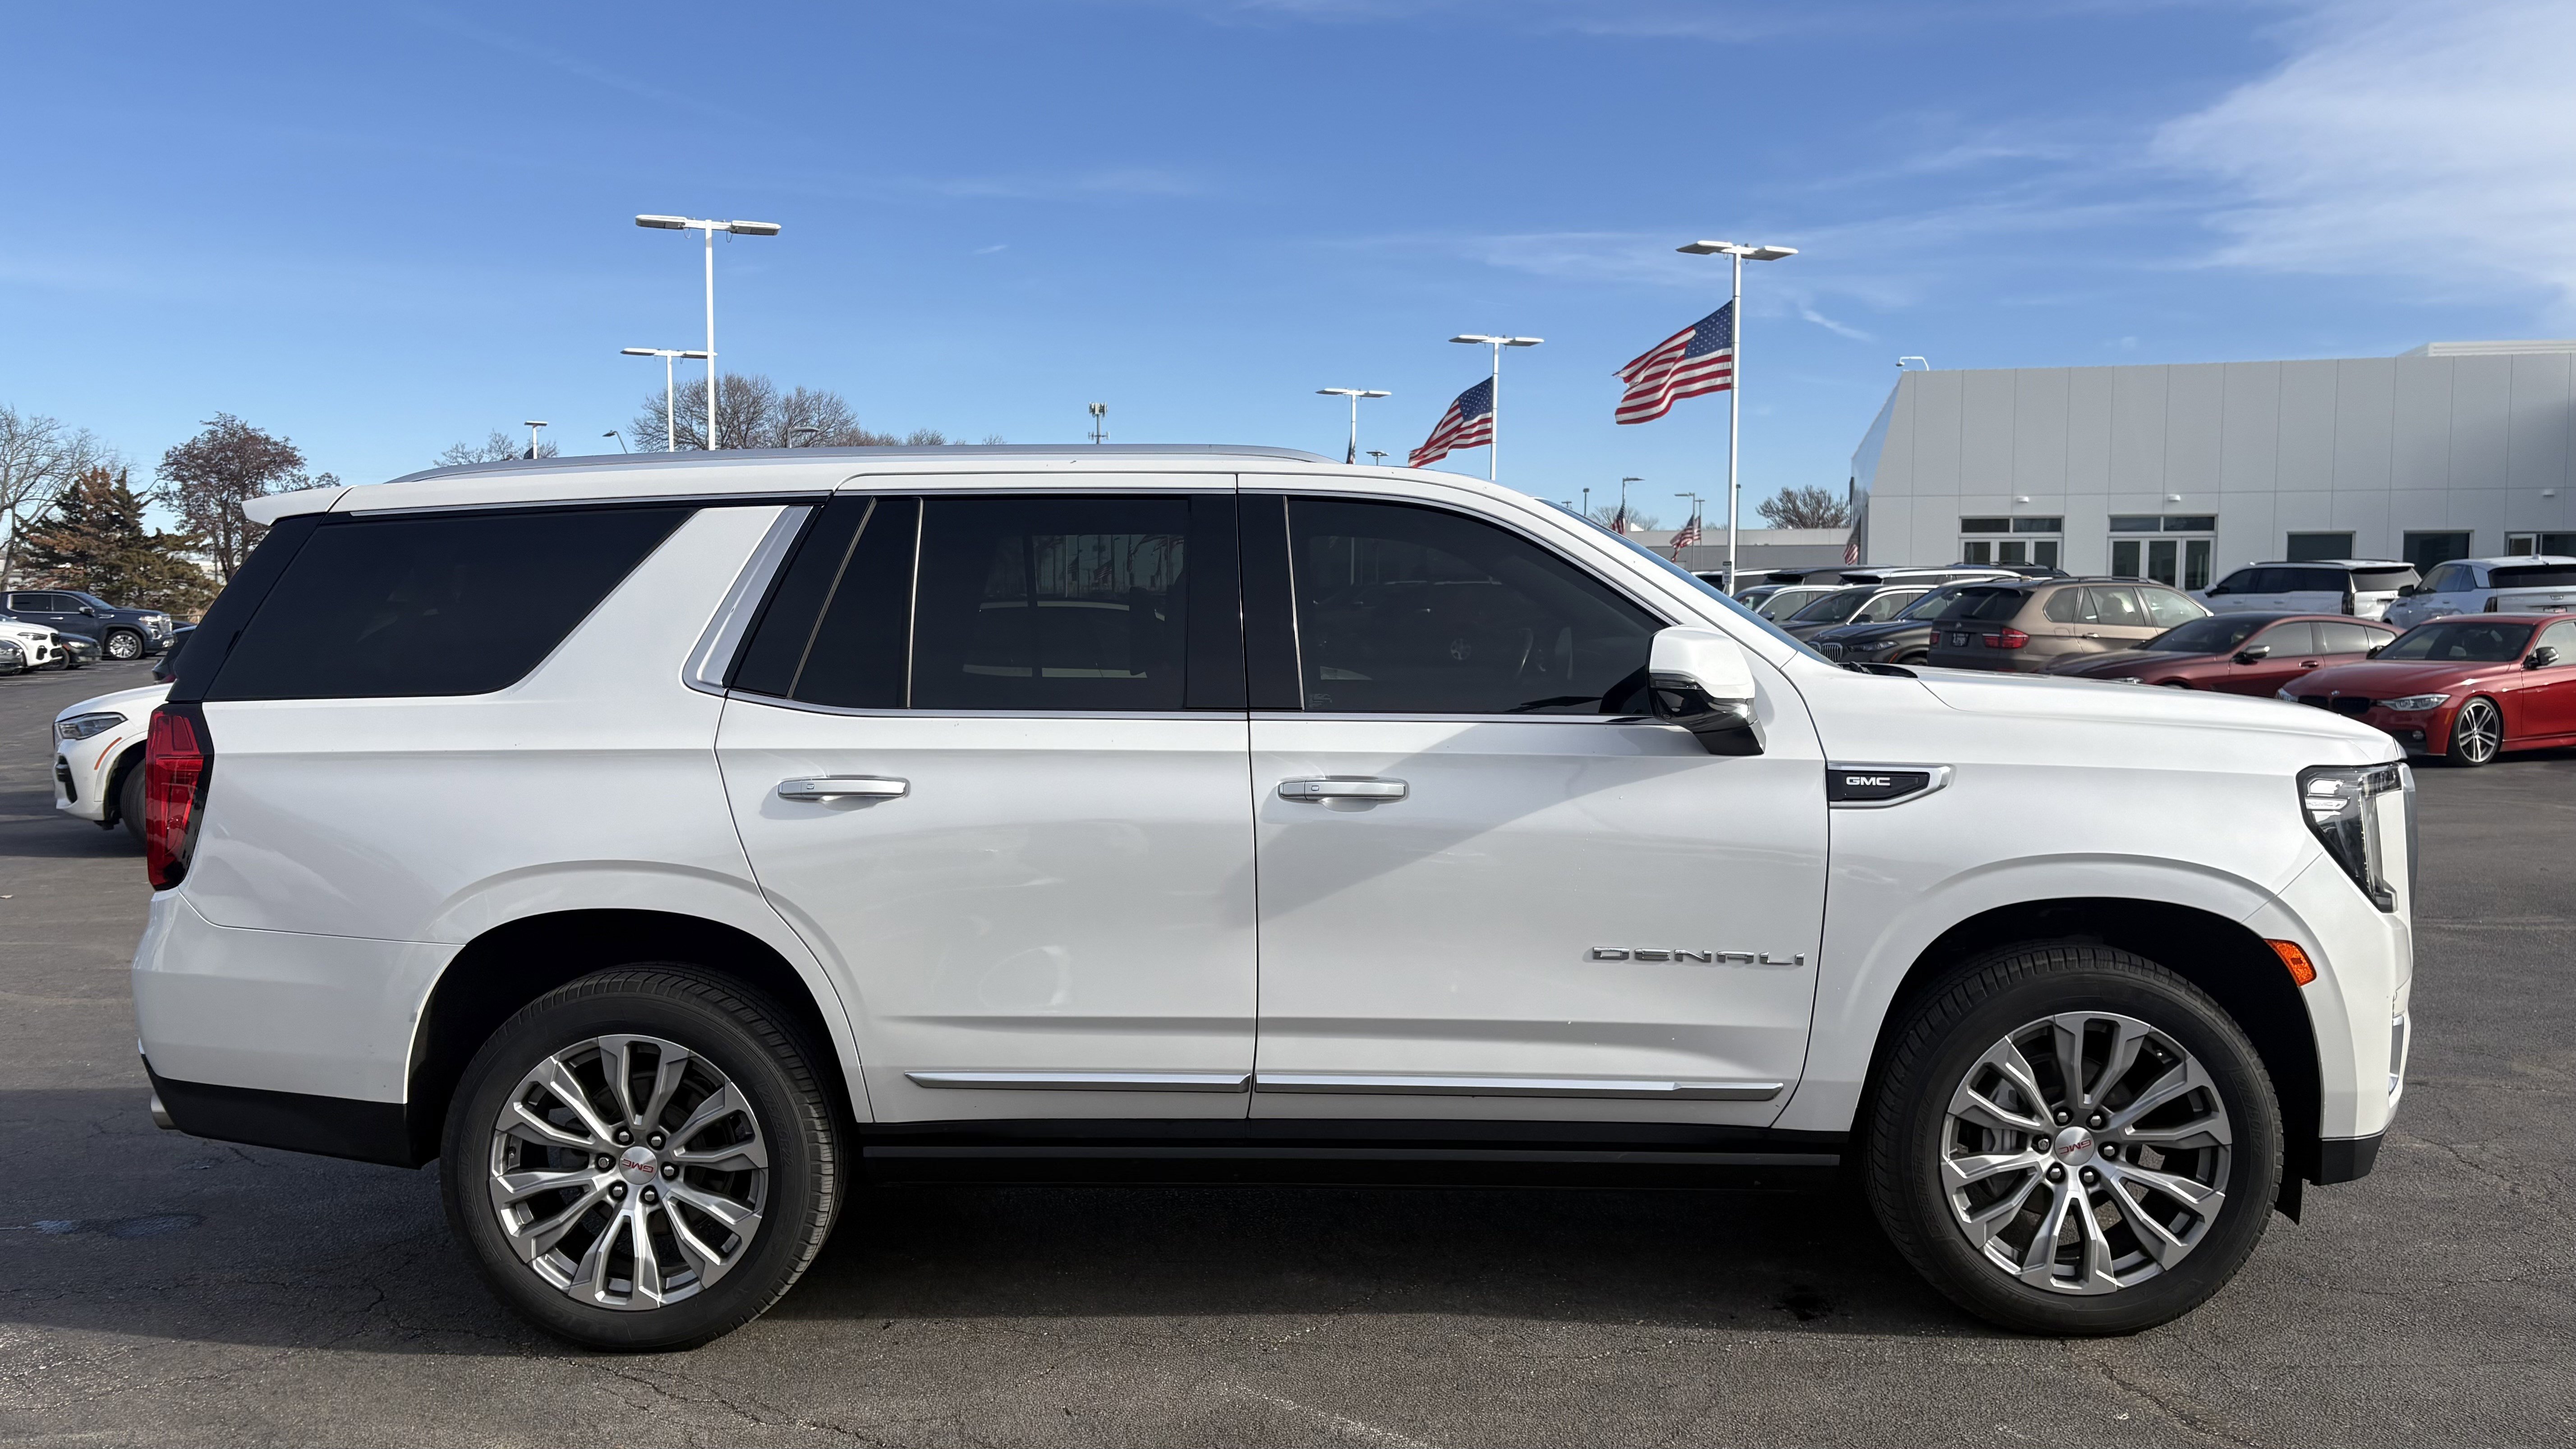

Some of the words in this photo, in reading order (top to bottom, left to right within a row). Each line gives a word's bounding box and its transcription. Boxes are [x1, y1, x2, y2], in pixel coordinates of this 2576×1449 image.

[1846, 776, 1891, 786] GMC
[1593, 947, 1805, 966] DENALI
[2058, 1139, 2092, 1154] GMC
[622, 1159, 654, 1173] GMC
